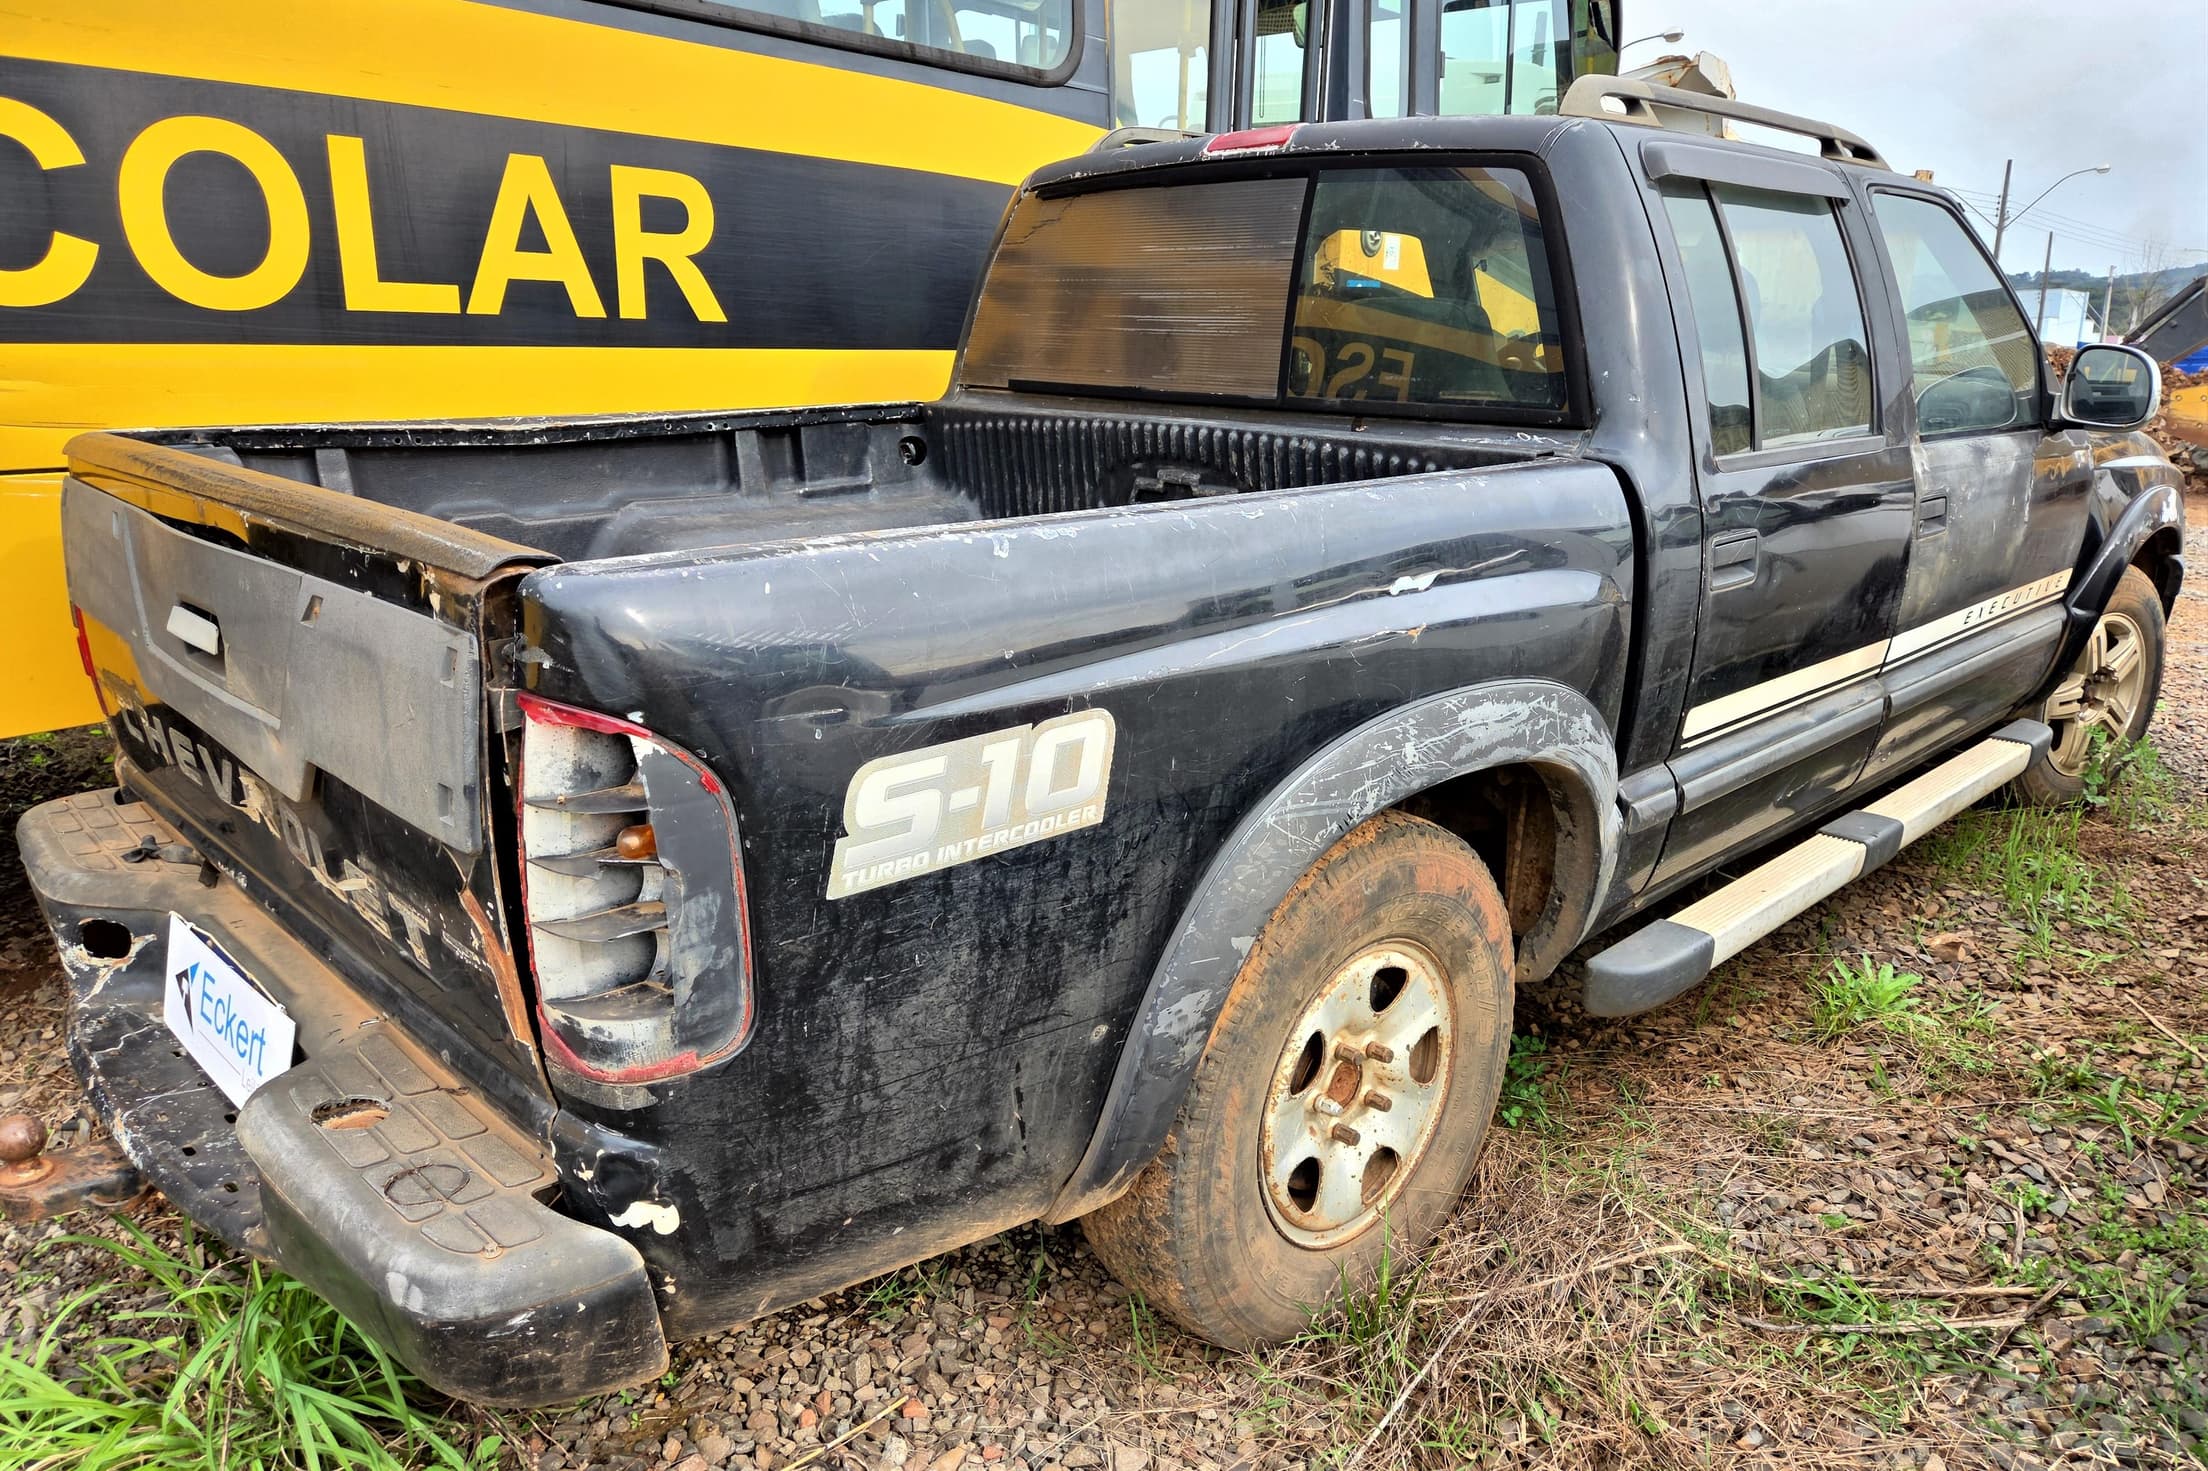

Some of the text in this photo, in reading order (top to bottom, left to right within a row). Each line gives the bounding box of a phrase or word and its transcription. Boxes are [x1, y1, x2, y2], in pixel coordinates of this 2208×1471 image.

[1963, 575, 2063, 625] EXECUTIVE
[845, 718, 1107, 868] S-10
[841, 804, 1099, 888] TURBO INTERCOOLER
[200, 970, 266, 1077] Eckert
